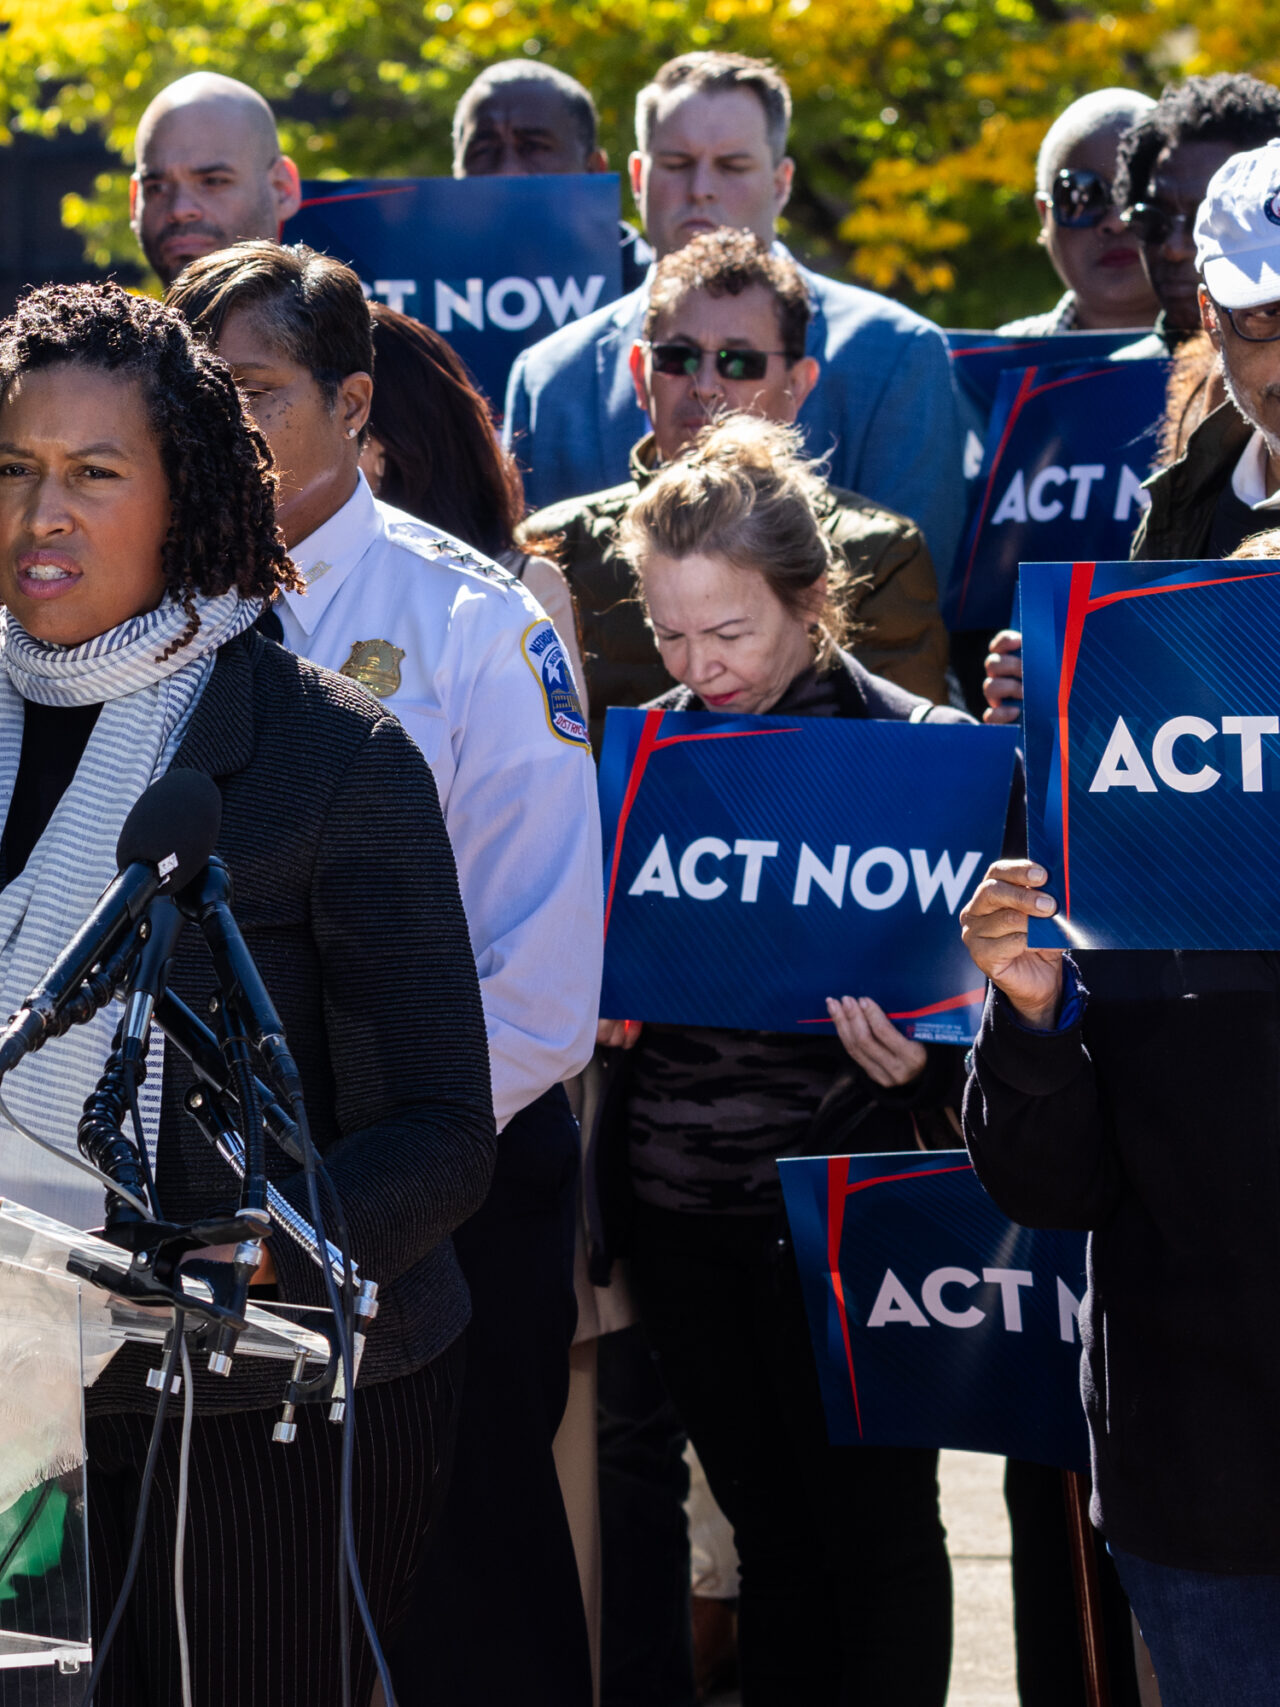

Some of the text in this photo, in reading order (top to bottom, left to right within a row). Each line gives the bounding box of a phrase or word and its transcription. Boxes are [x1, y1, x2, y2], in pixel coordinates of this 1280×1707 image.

[434, 274, 606, 332] NOW
[991, 464, 1106, 526] ACT
[1088, 714, 1280, 794] ACT
[628, 833, 984, 916] ACT NOW
[866, 1266, 1034, 1333] ACT
